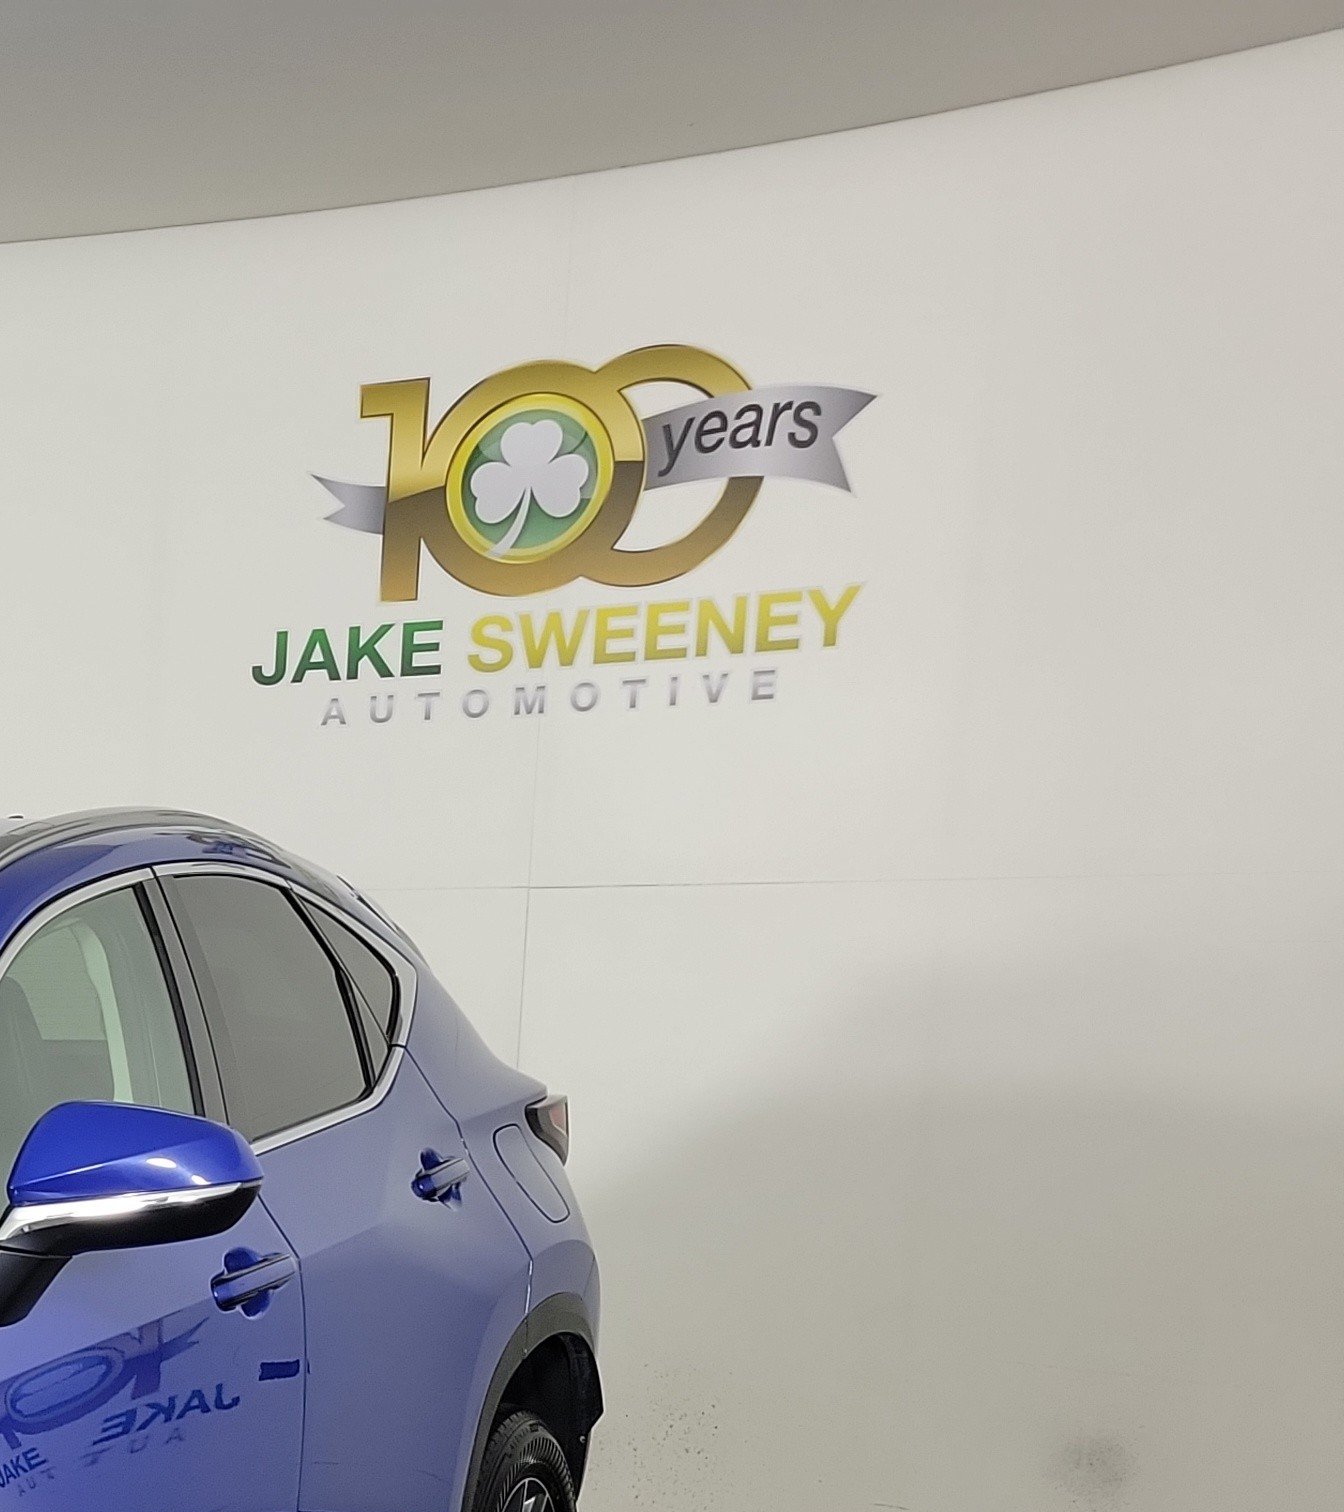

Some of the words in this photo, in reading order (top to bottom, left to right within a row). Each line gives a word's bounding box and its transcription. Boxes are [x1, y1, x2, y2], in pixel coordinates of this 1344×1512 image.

[359, 343, 765, 603] 100
[657, 398, 823, 478] years
[251, 619, 445, 687] JAKE
[466, 584, 867, 673] SWEENEY
[320, 668, 778, 727] AUTOMOTIVE
